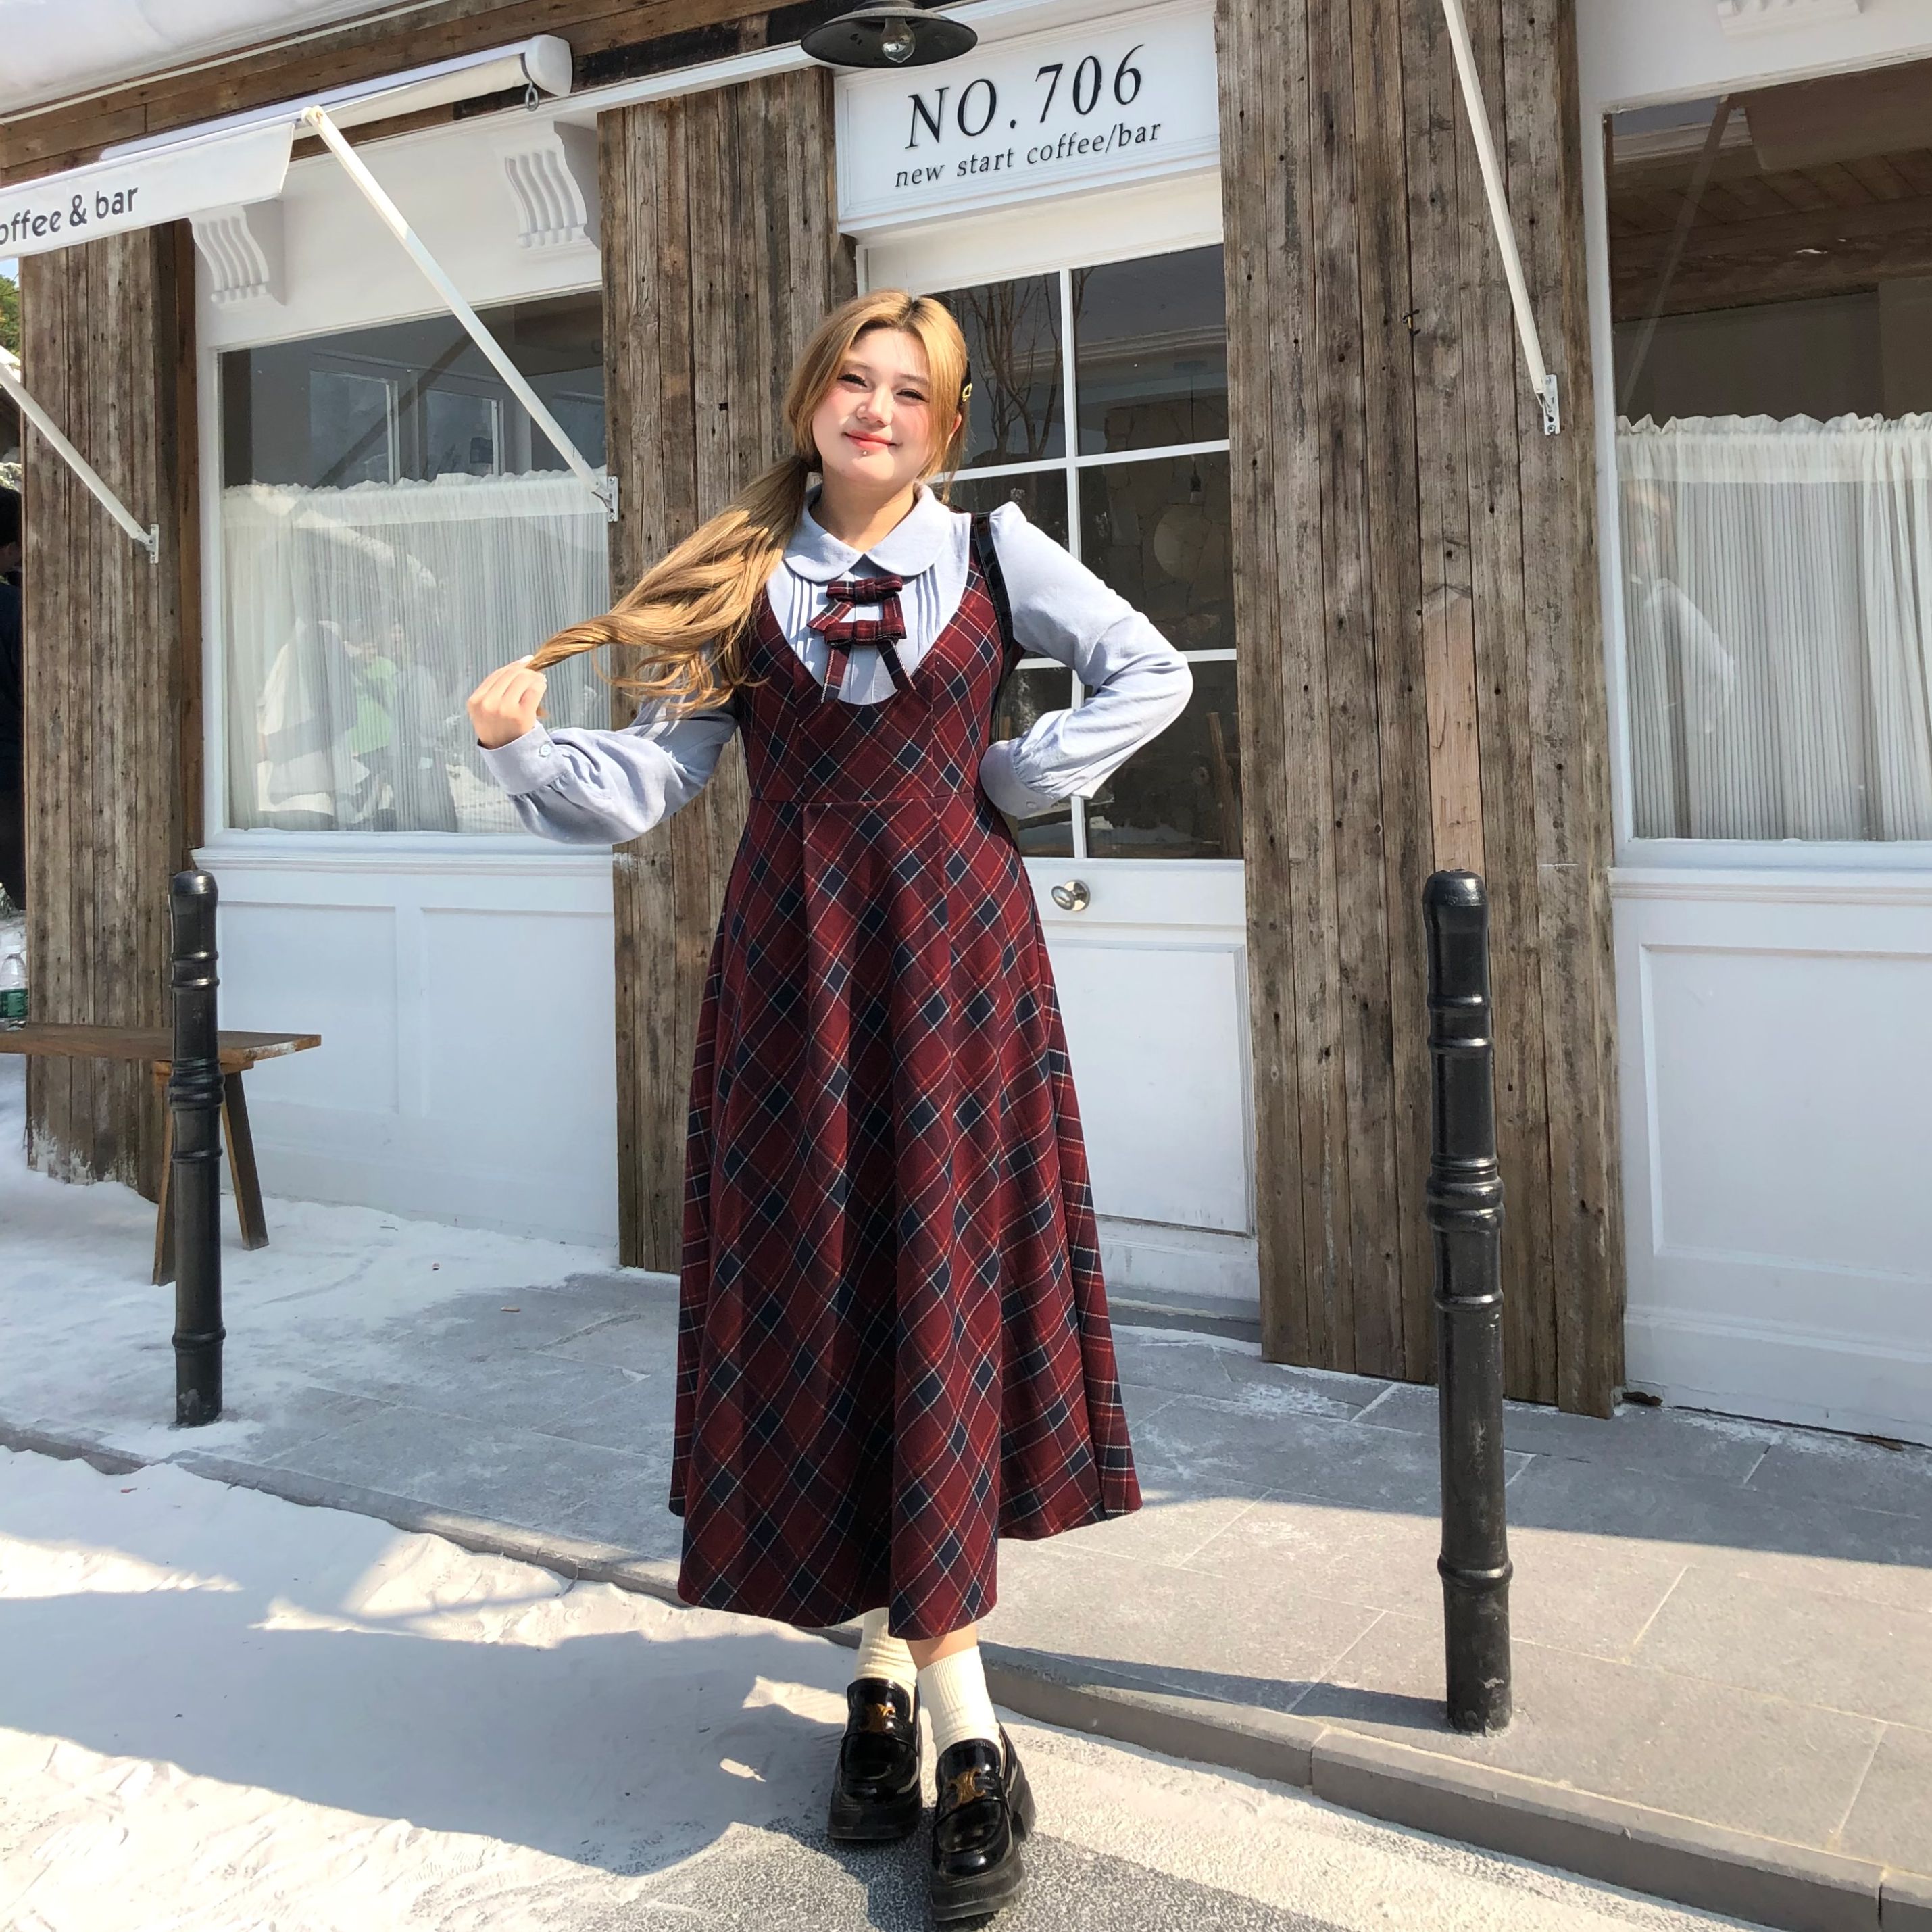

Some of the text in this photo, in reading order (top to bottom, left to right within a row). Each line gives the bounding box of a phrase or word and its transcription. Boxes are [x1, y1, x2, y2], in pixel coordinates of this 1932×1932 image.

[895, 122, 1162, 188] new start coffee/bar
[69, 194, 88, 227] &
[95, 187, 139, 220] bar
